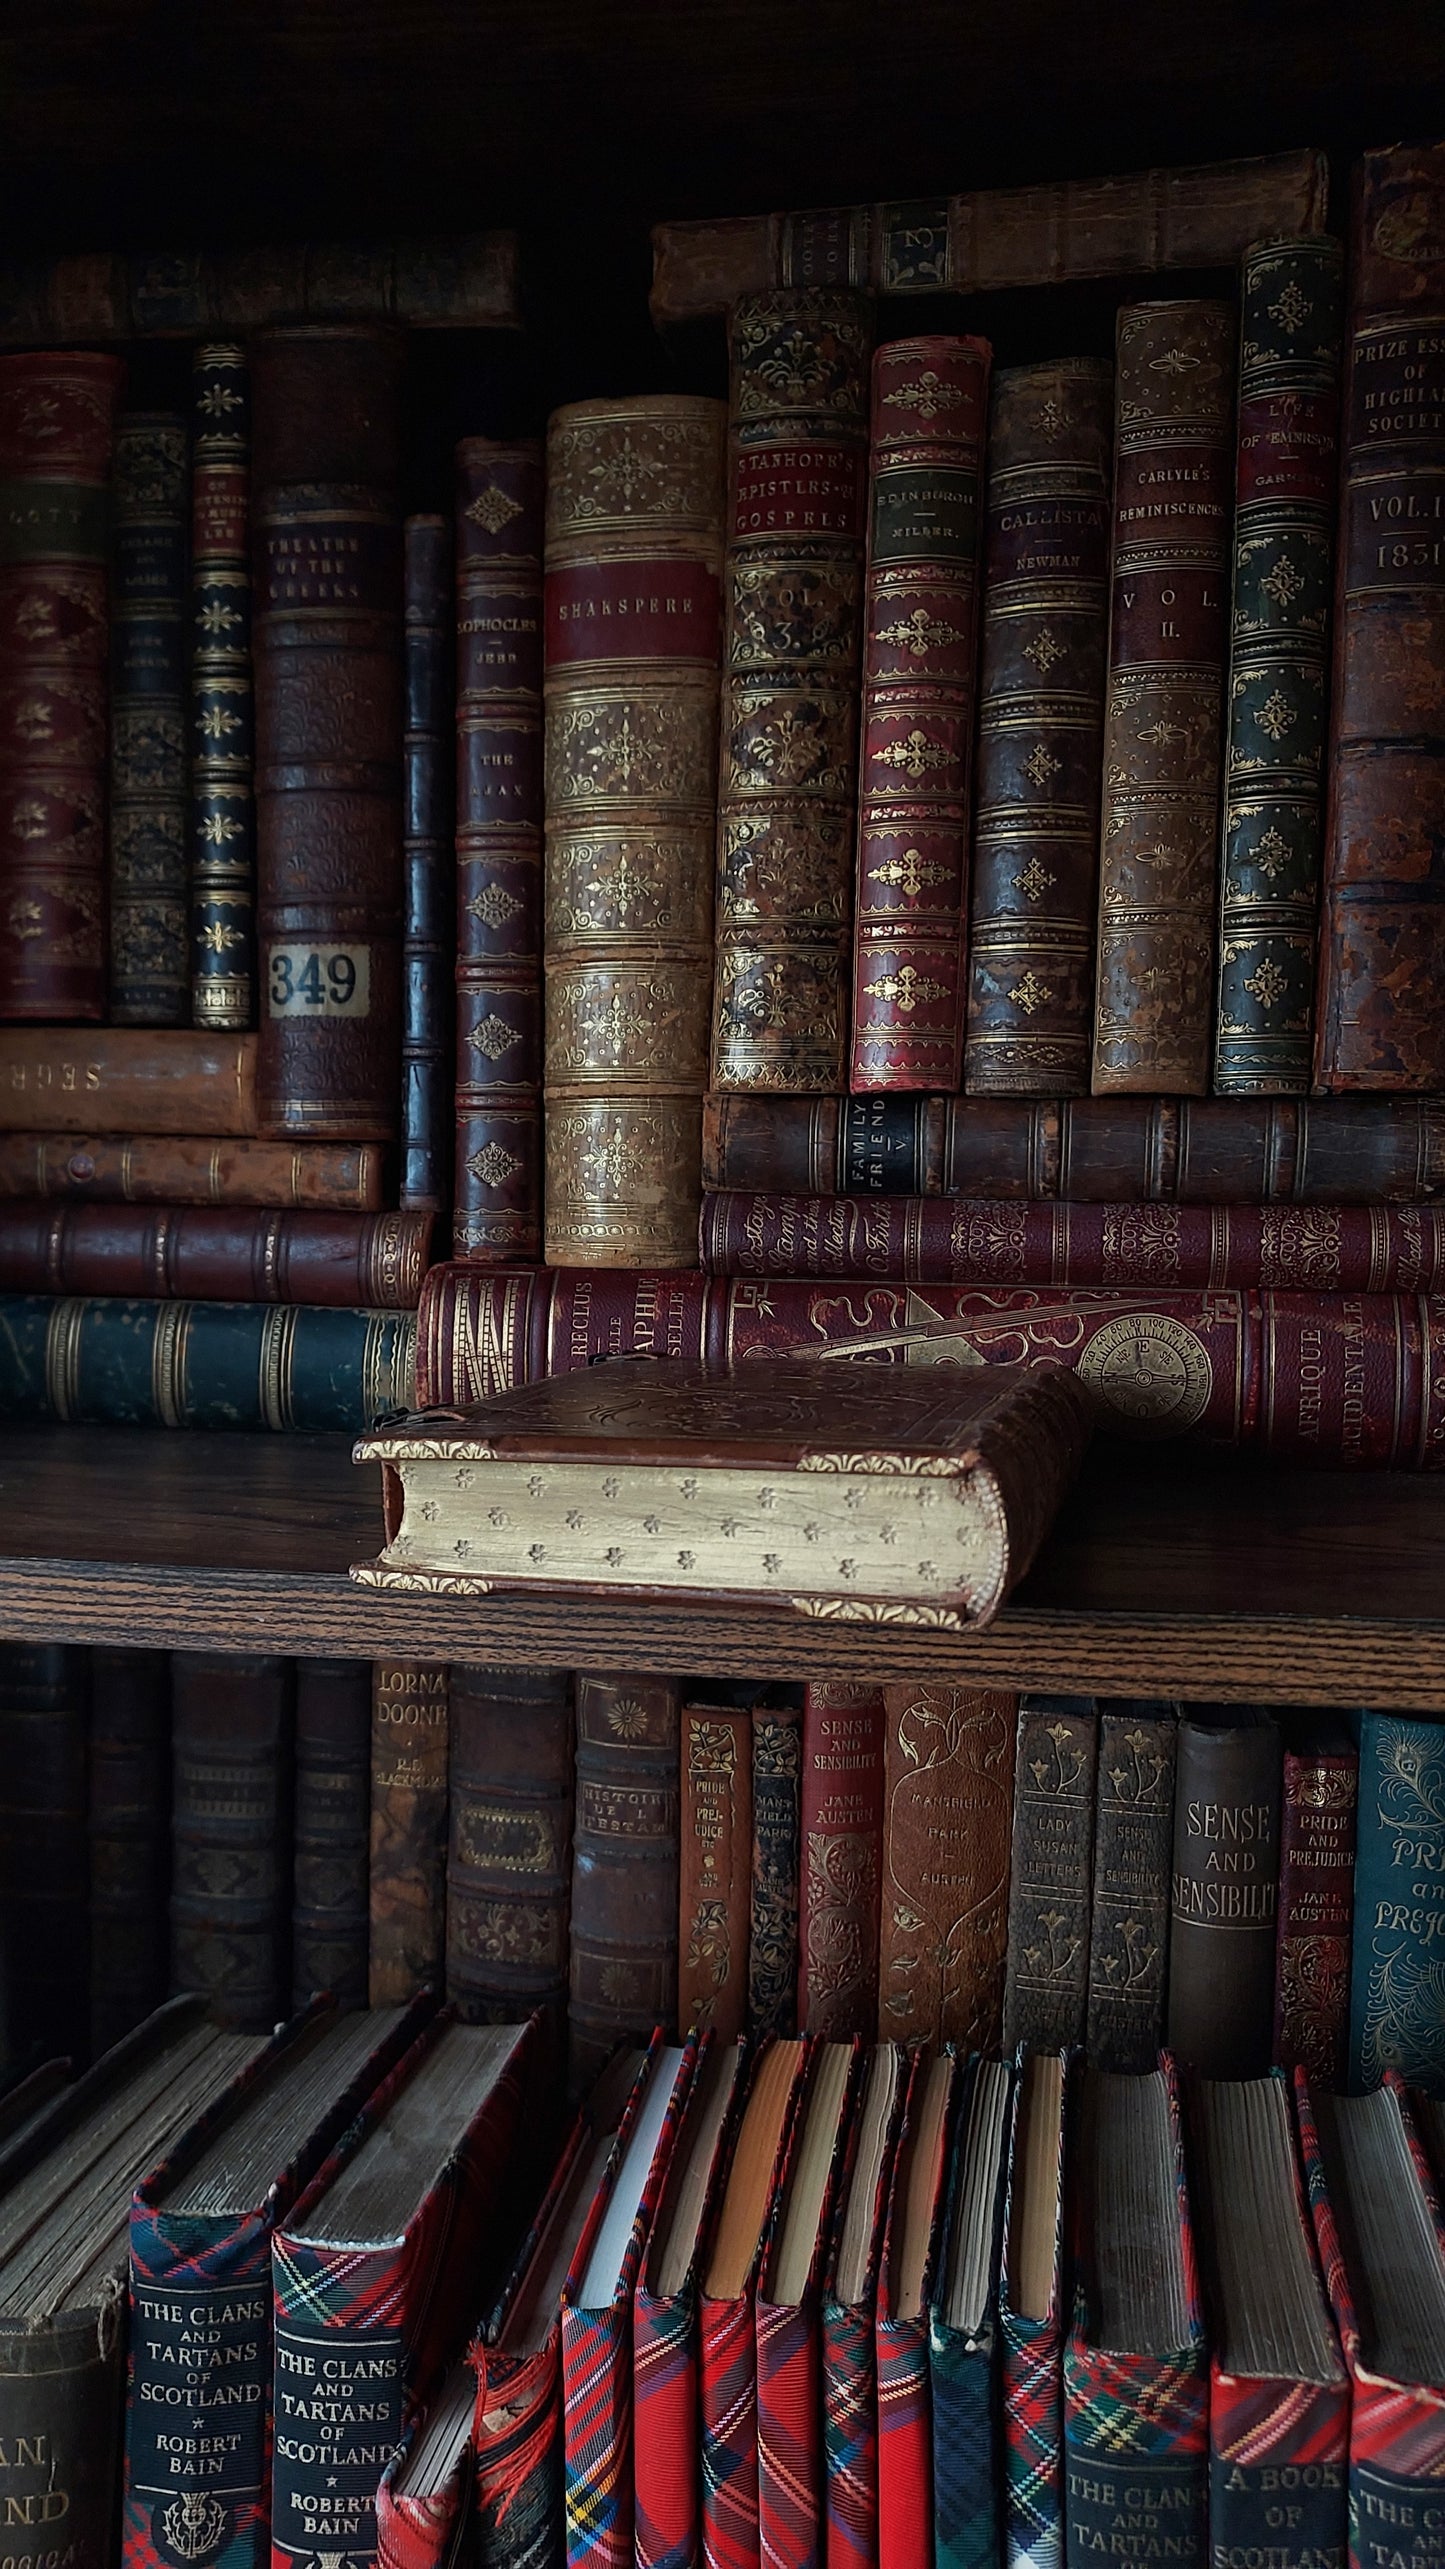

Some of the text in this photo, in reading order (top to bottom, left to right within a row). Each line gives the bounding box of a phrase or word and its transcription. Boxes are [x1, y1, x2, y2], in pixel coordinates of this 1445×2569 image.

[1354, 340, 1408, 364] PRIZE
[1404, 363, 1427, 381] OF
[1241, 435, 1260, 449] OF
[738, 452, 853, 474] STANHOPE'S
[1138, 463, 1210, 484] CARLYLE'S
[877, 490, 973, 506] EDINBURGH
[736, 509, 847, 529] GOSPELS
[1000, 510, 1098, 532] CALLISTA
[1119, 503, 1225, 522] REMINISCENCES
[1015, 555, 1081, 571] NEWMAN
[757, 588, 824, 609] VOL.
[1123, 589, 1217, 609] VOL.
[559, 598, 693, 620] SHAKSPERE
[457, 617, 538, 634] SOPHOCLES
[1161, 620, 1181, 638] II.
[481, 755, 514, 766] THE
[470, 785, 523, 796] AJAX
[269, 953, 356, 1005] 349
[852, 1103, 869, 1181] FAMILY
[870, 1099, 887, 1188] FRIEND
[768, 1197, 800, 1274] Stamps
[801, 1199, 820, 1274] and their
[821, 1199, 848, 1274] Collection
[862, 1200, 892, 1256] Firth
[571, 1281, 592, 1356] RECLUS
[666, 1292, 684, 1356] SELLE
[1129, 1319, 1141, 1327] 80
[1149, 1319, 1164, 1329] 100
[1109, 1323, 1122, 1334] 60
[1168, 1324, 1183, 1337] 120
[1096, 1334, 1107, 1346] 40
[1139, 1339, 1150, 1353] E
[1184, 1335, 1197, 1350] 140
[1085, 1351, 1095, 1363] 20
[1195, 1353, 1206, 1369] 160
[1198, 1373, 1207, 1389] 180
[1297, 1328, 1325, 1443] AFRIQUE
[1342, 1300, 1366, 1464] OCCIDENTALE
[378, 1671, 446, 1694] LORNA
[820, 1718, 872, 1735] SENSE
[830, 1740, 861, 1752] AND
[814, 1752, 877, 1771] SENSIBILITY
[696, 1780, 725, 1794] PRIDE
[702, 1797, 718, 1806] AND
[824, 1796, 864, 1807] JANE
[911, 1793, 991, 1809] MANSFIELD
[755, 1810, 791, 1822] FIELD
[815, 1807, 873, 1825] AUSTEN
[1187, 1801, 1270, 1844] SENSE
[1300, 1813, 1348, 1831] PRIDE
[695, 1824, 724, 1838] UDICE
[757, 1825, 792, 1839] PARK
[928, 1826, 968, 1840] PARK
[1039, 1818, 1072, 1833] LADY
[1116, 1825, 1151, 1840] SENSE
[1033, 1840, 1077, 1856] SUSAN
[1308, 1834, 1338, 1848] AND
[1120, 1849, 1145, 1862] AND
[1205, 1852, 1257, 1872] AND
[1289, 1850, 1354, 1869] PREJUDICE
[1028, 1861, 1081, 1877] LETTERS
[1106, 1869, 1160, 1884] SENSIBILITY
[921, 1872, 973, 1885] AUSTEN
[1299, 1893, 1342, 1906] JANE
[1289, 1907, 1350, 1923] AUSTEN
[139, 2299, 265, 2326] THE CLANS
[180, 2329, 222, 2343] AND
[146, 2341, 258, 2367] TARTANS
[277, 2346, 398, 2380] THE CLANS
[186, 2371, 212, 2385] OF
[140, 2383, 261, 2409] SCOTLAND
[312, 2383, 355, 2398] AND
[280, 2394, 392, 2422] TARTANS
[319, 2425, 345, 2441] OF
[155, 2434, 243, 2454] ROBERT
[276, 2435, 401, 2466] SCOTLAND
[169, 2455, 226, 2476] BAIN
[1223, 2464, 1343, 2491] A BOOK
[1068, 2473, 1116, 2507] THE
[1264, 2506, 1304, 2529] OF
[1359, 2488, 1415, 2529] THE
[303, 2514, 360, 2535] BAIN
[1111, 2513, 1159, 2529] AND
[1072, 2521, 1197, 2557] TARTANS
